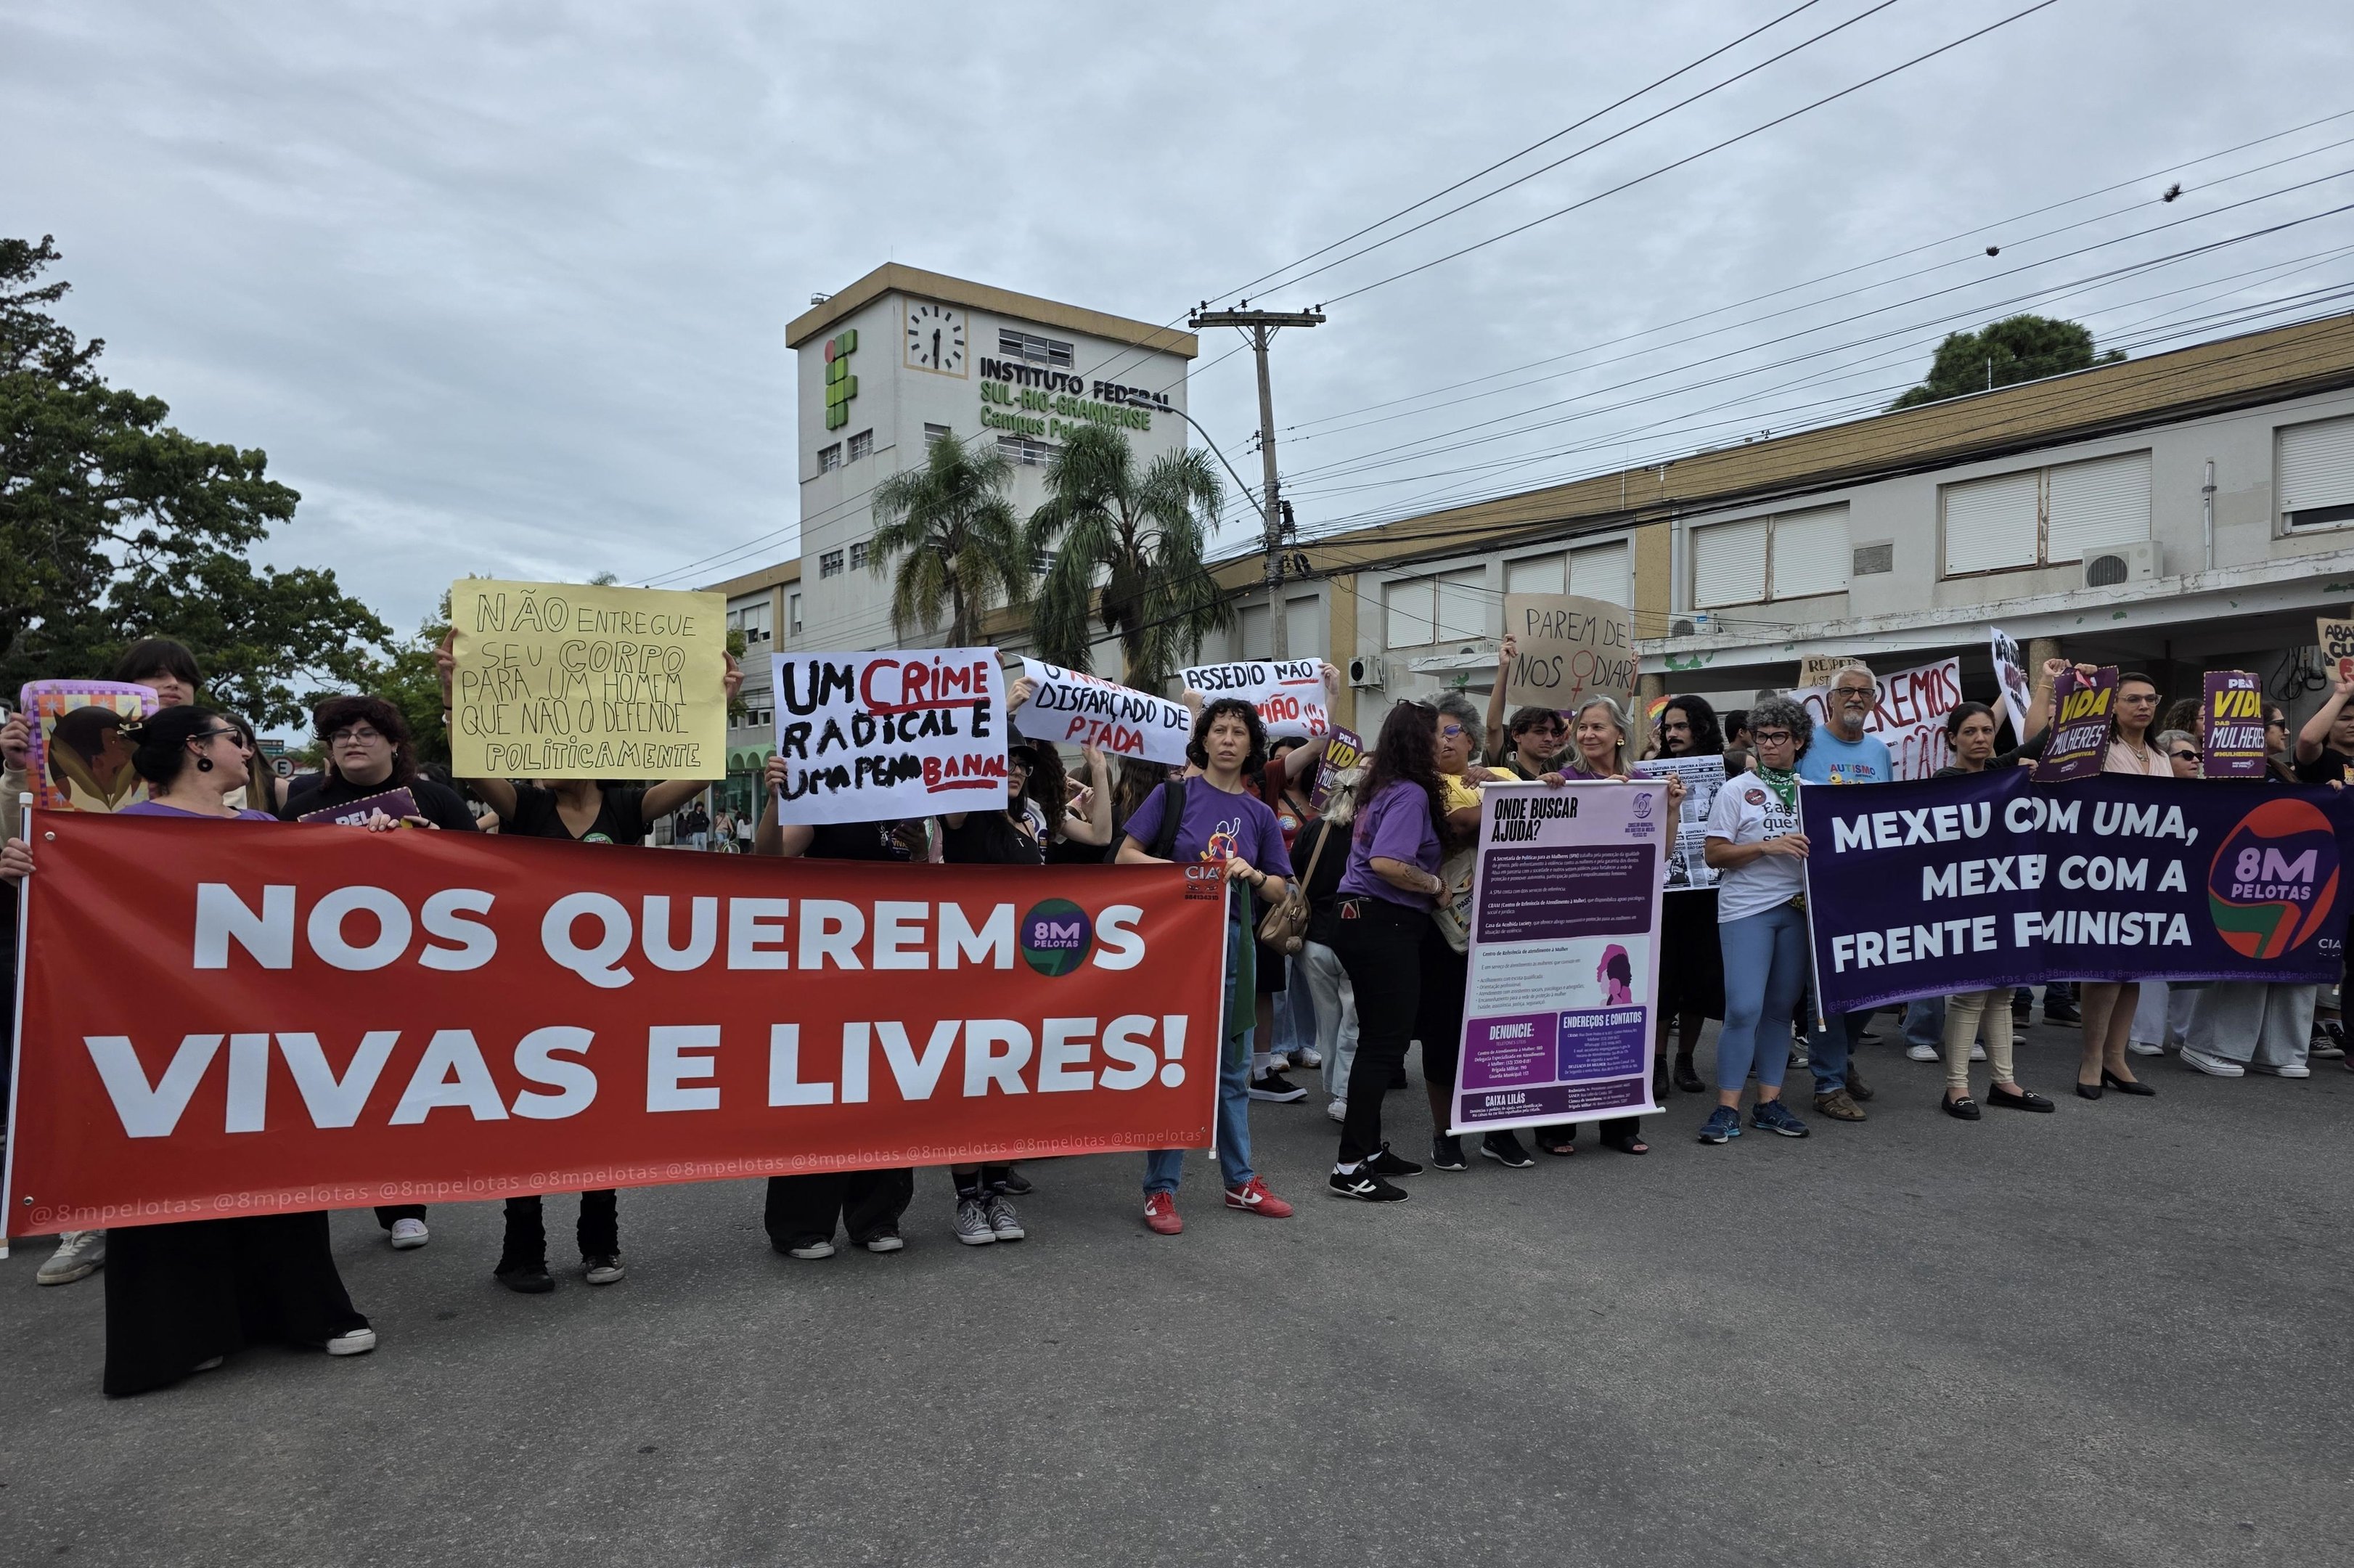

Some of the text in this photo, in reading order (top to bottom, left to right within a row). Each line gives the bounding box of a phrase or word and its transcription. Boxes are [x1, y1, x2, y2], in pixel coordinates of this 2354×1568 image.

[981, 357, 1174, 413] INSTITUTO FEDERAL
[980, 380, 1152, 430] SUL-RIO-GRANDENSE
[981, 405, 1046, 436] Campus
[477, 589, 696, 636] NÃO ENTREGUE
[1527, 608, 1626, 648] PAREM DE
[2325, 624, 2354, 642] ABA
[482, 640, 685, 674] SEU CORPO
[1273, 661, 1313, 680] NÃO
[1513, 653, 1564, 688] NOS
[462, 667, 687, 705] PARA UM HOMEM
[782, 660, 854, 716] UM
[860, 656, 989, 710] CRiME
[461, 697, 689, 738] QUE NÃO O DEFENDE
[1036, 682, 1189, 731] DISFARÇADO DE
[2059, 688, 2112, 724] VIDA
[2214, 690, 2262, 719] VIDA
[782, 700, 991, 760] RADiCAL E
[1065, 715, 1144, 756] PIADA
[1339, 732, 1357, 748] PELA
[2047, 724, 2106, 756] MULHERES
[2208, 727, 2265, 748] MULHERES
[277, 761, 287, 775] E
[779, 764, 851, 801] UMA
[923, 754, 1008, 786] BANAL
[1830, 764, 1876, 775] AUTISMO
[1495, 797, 1578, 820] ONDE BUSCAR
[1762, 802, 1773, 815] E
[1763, 818, 1793, 832] que
[1492, 820, 1541, 842] AJUDA?
[1831, 801, 1991, 854] MEXEU
[2092, 801, 2199, 846] UMA,
[1185, 866, 1219, 881] CIA
[2058, 855, 2149, 892] COM
[2157, 859, 2187, 892] A
[2235, 847, 2318, 883] 8M
[2231, 883, 2311, 900] PELOTAS
[194, 883, 498, 971] NOS
[1034, 922, 1080, 939] 8M
[1831, 910, 2192, 973] FRENTE FMINISTA
[2318, 938, 2342, 950] CIA
[1489, 1022, 1534, 1040] DENUNCIE:
[1564, 1011, 1642, 1029] ENDEREÇOS E CONTATOS
[83, 1014, 1188, 1138] VIVAS E LIVRES!
[1485, 1091, 1525, 1107] CAIXA LILÁS
[30, 1129, 1202, 1227] @8mpelotas @8mpelotas @8mpelotas @8mpelotas @8mpelotas @8mpelotas @8mpelotas @8mpelotas @8mpelotas
